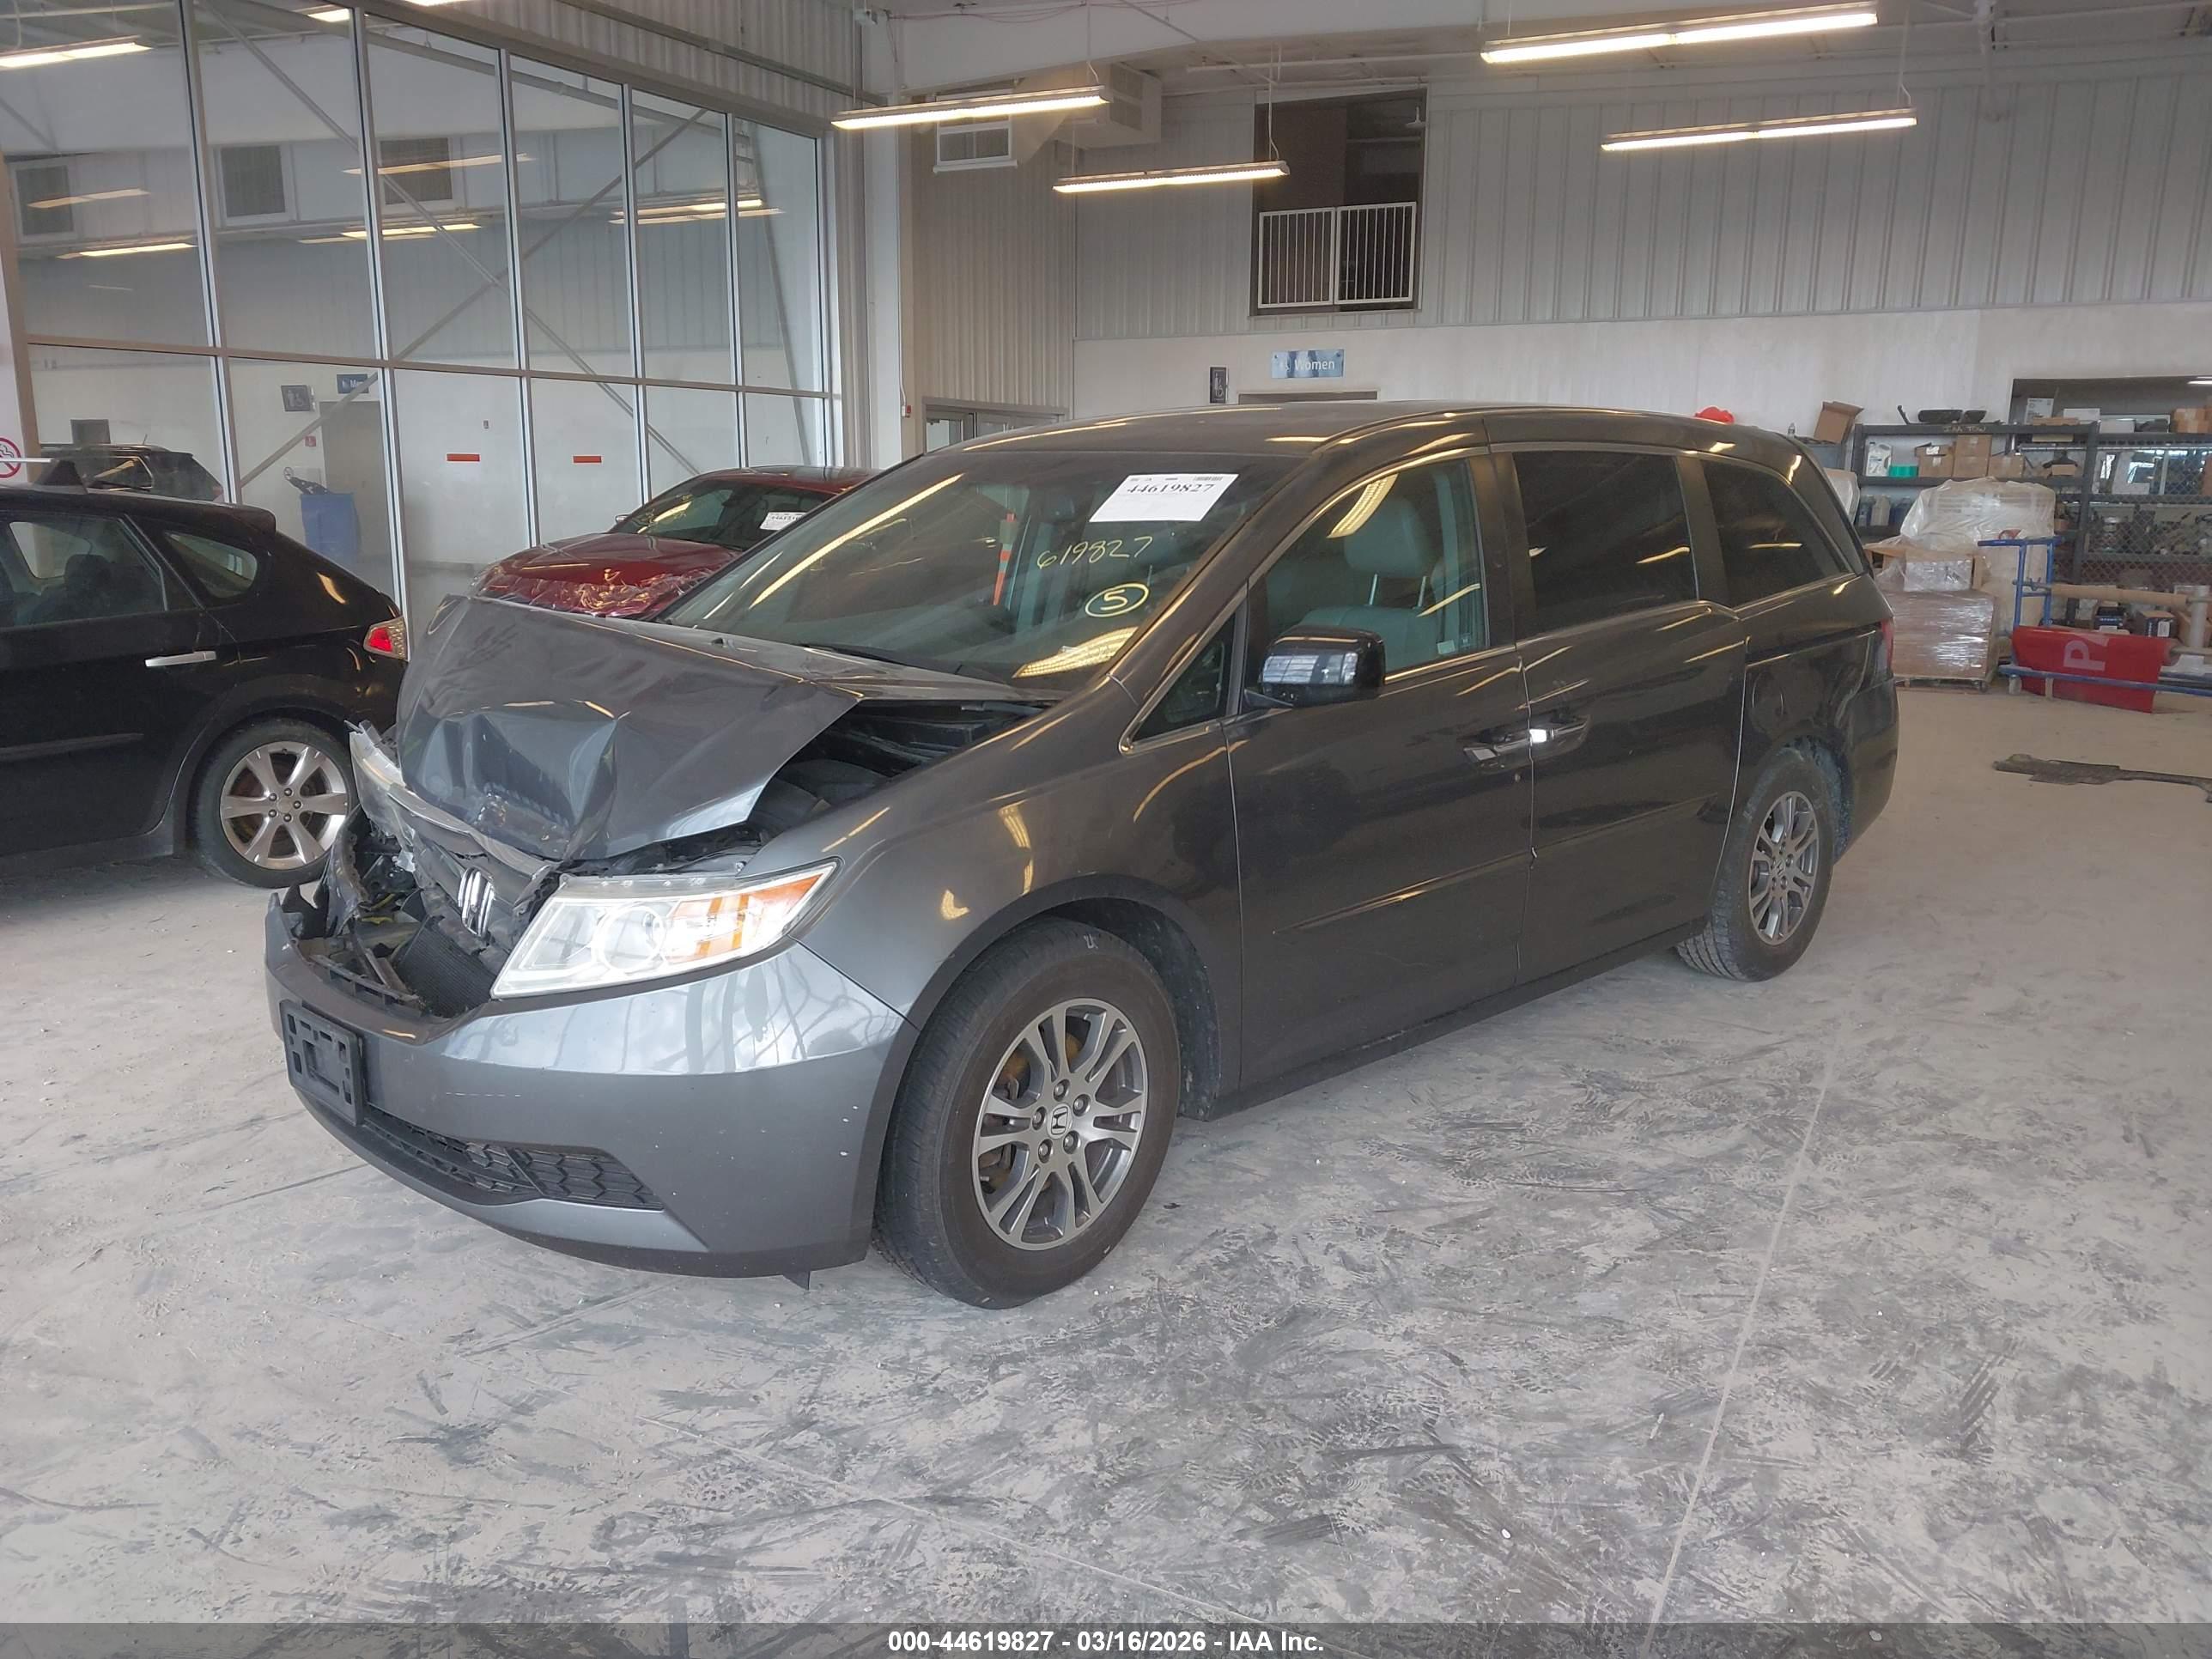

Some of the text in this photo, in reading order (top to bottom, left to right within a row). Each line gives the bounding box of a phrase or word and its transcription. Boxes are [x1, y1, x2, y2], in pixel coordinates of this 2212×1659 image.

[1294, 359, 1335, 371] Women
[1127, 483, 1215, 494] 44619827
[1036, 536, 1153, 569] 619827
[1100, 588, 1128, 611] 5
